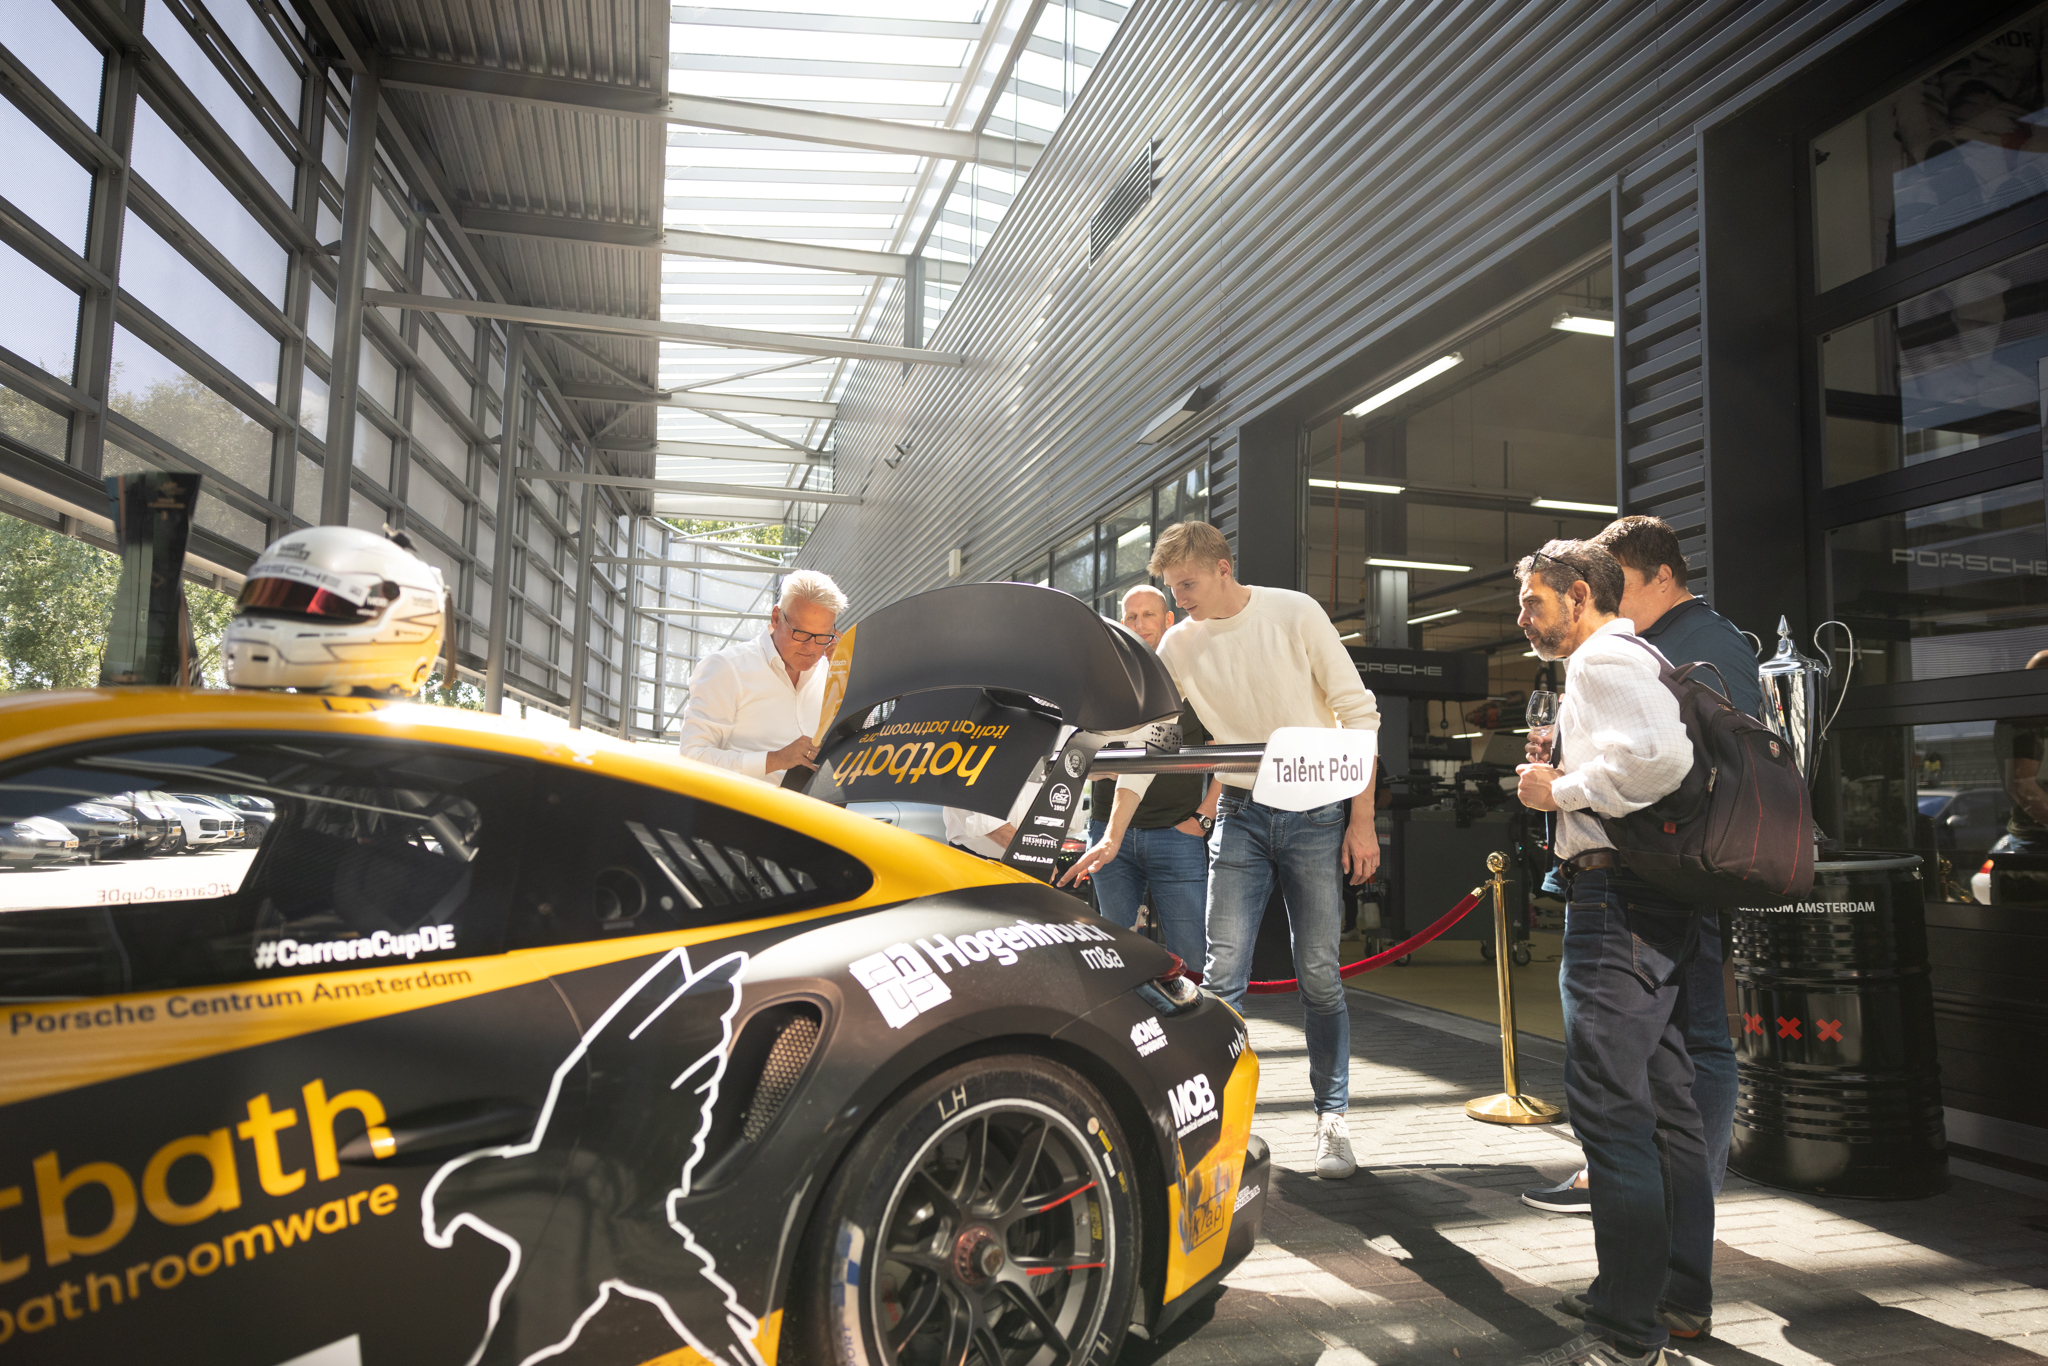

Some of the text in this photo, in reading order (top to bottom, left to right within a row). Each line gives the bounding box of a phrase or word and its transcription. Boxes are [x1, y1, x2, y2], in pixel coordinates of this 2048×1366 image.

[1892, 549, 2048, 577] PORSCHE
[1356, 662, 1443, 677] ORSCHE
[951, 720, 1010, 741] italian
[832, 741, 997, 787] hotbath
[1272, 757, 1364, 783] Talent Pool
[1795, 901, 1876, 913] AMSTERDAM
[253, 923, 457, 970] #CarreraCupDE
[915, 919, 1117, 974] Hogenhouck
[1080, 946, 1126, 970] m&a
[9, 966, 473, 1036] Porsche Centrum Amsterdam
[1167, 1073, 1216, 1129] MOB
